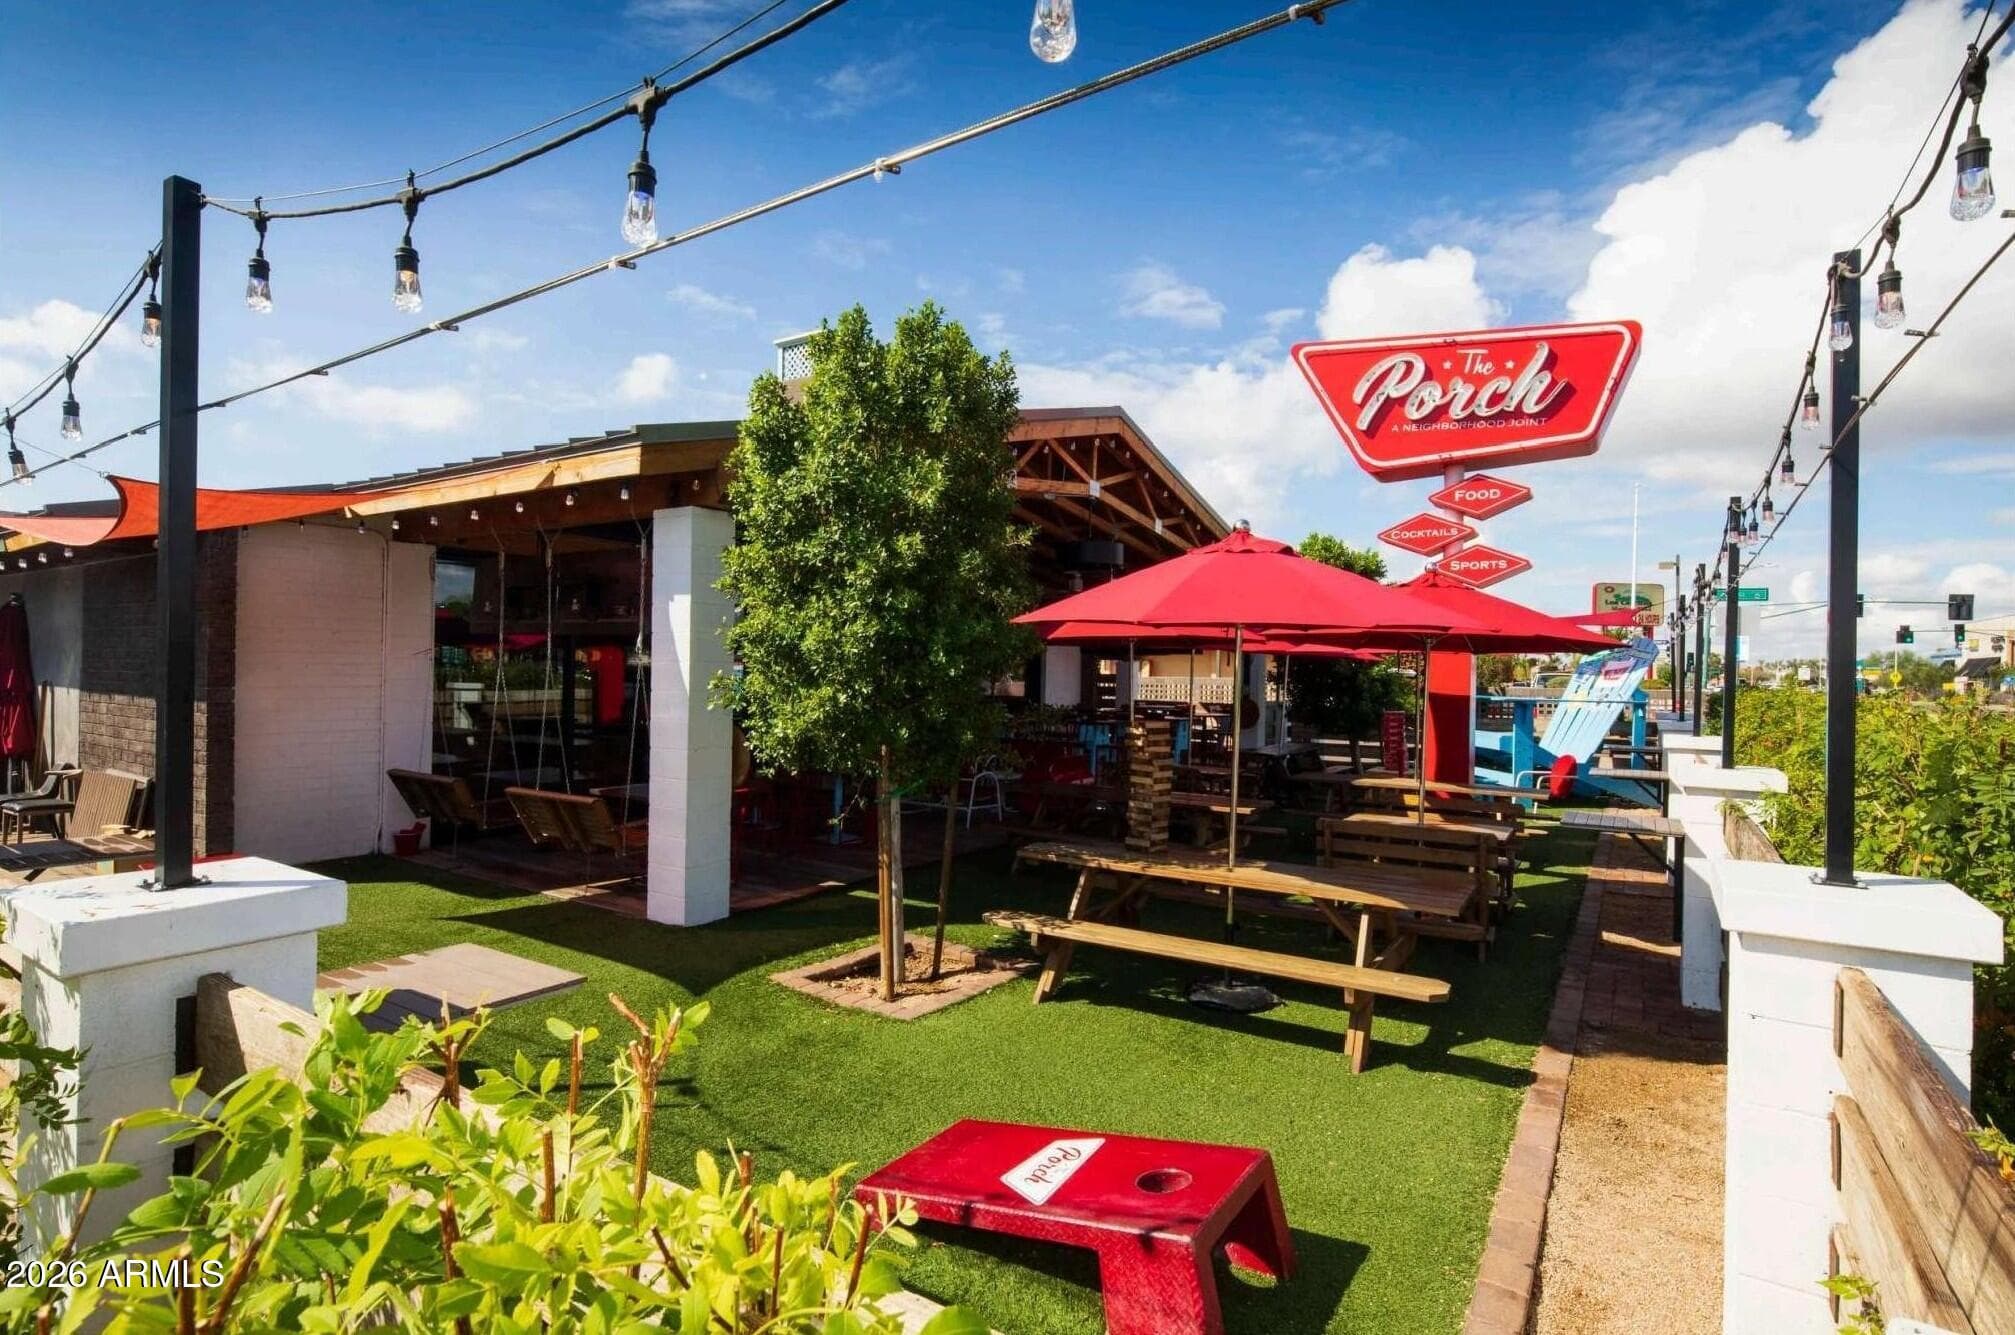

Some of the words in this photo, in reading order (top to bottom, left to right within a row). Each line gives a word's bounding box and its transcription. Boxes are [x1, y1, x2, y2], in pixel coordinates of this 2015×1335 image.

[1456, 349, 1495, 375] The
[1352, 341, 1568, 431] Porch
[1391, 423, 1399, 432] A
[1402, 419, 1506, 432] NEIGHBORHOOD
[1508, 417, 1547, 428] JOINT
[1454, 488, 1501, 502] FOOD
[1391, 527, 1459, 540] COCKTAILS
[1450, 559, 1508, 571] SPORTS
[1024, 1147, 1081, 1184] Porch
